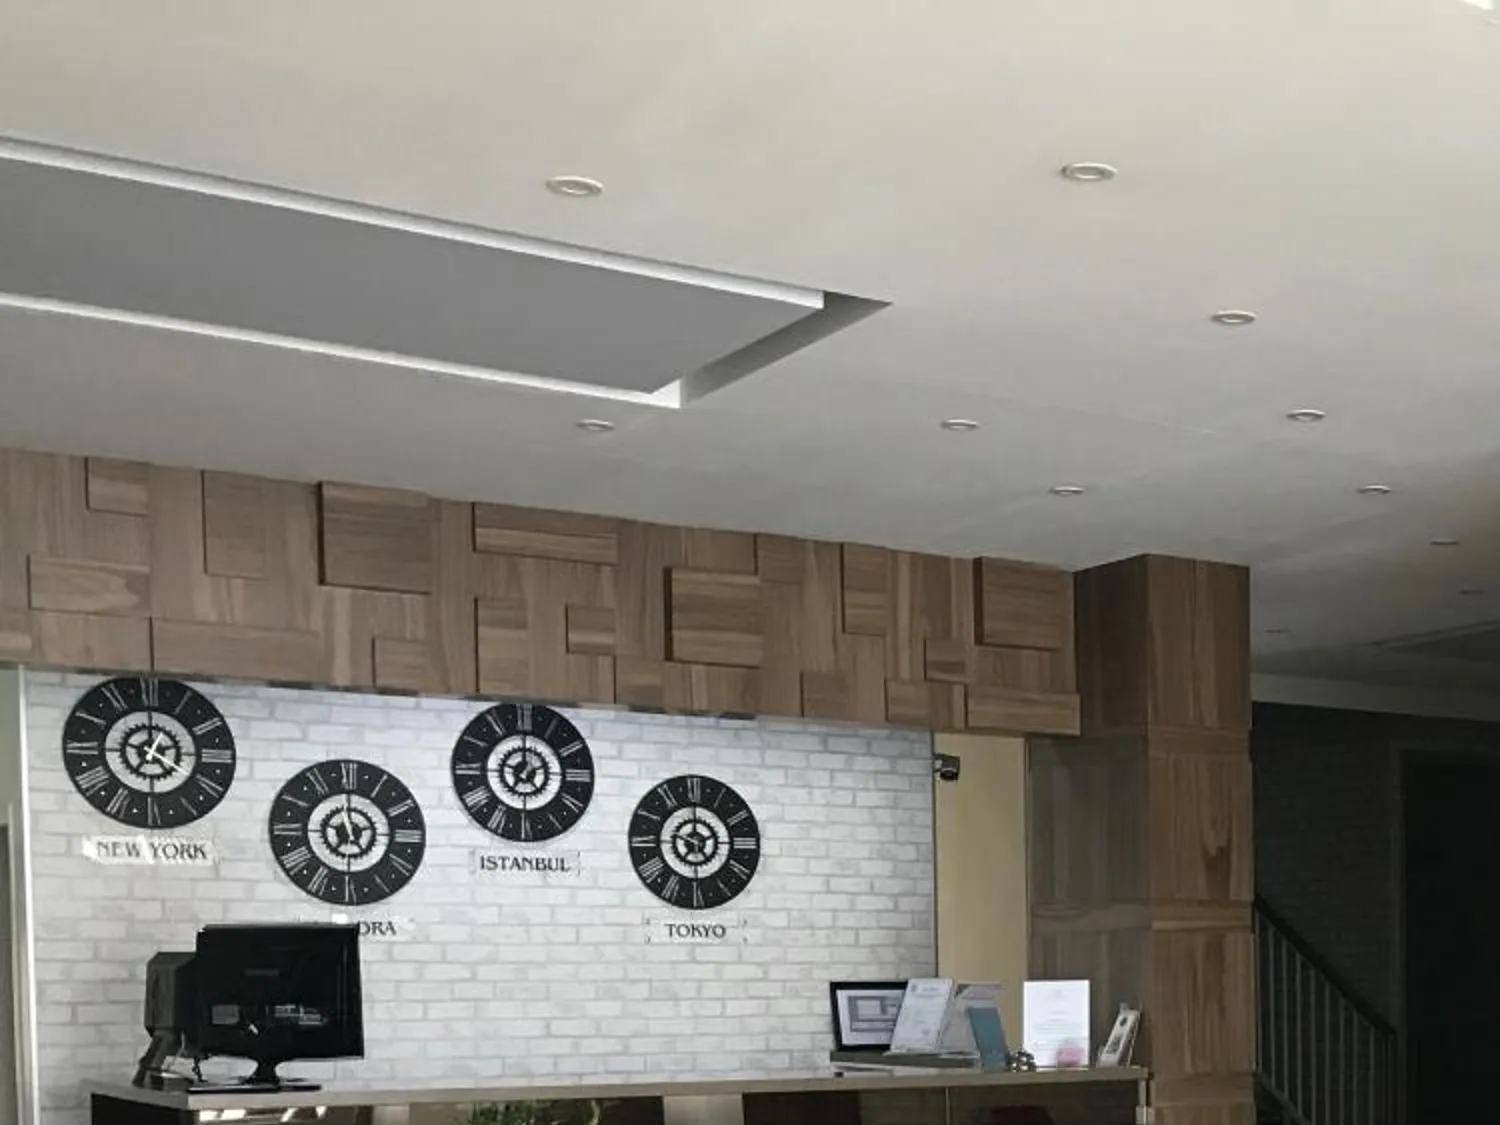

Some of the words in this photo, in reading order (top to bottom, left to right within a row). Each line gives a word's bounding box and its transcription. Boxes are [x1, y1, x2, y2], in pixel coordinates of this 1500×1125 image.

[97, 840, 141, 859] NEW
[151, 841, 207, 860] YORK
[666, 923, 727, 939] TOKYO
